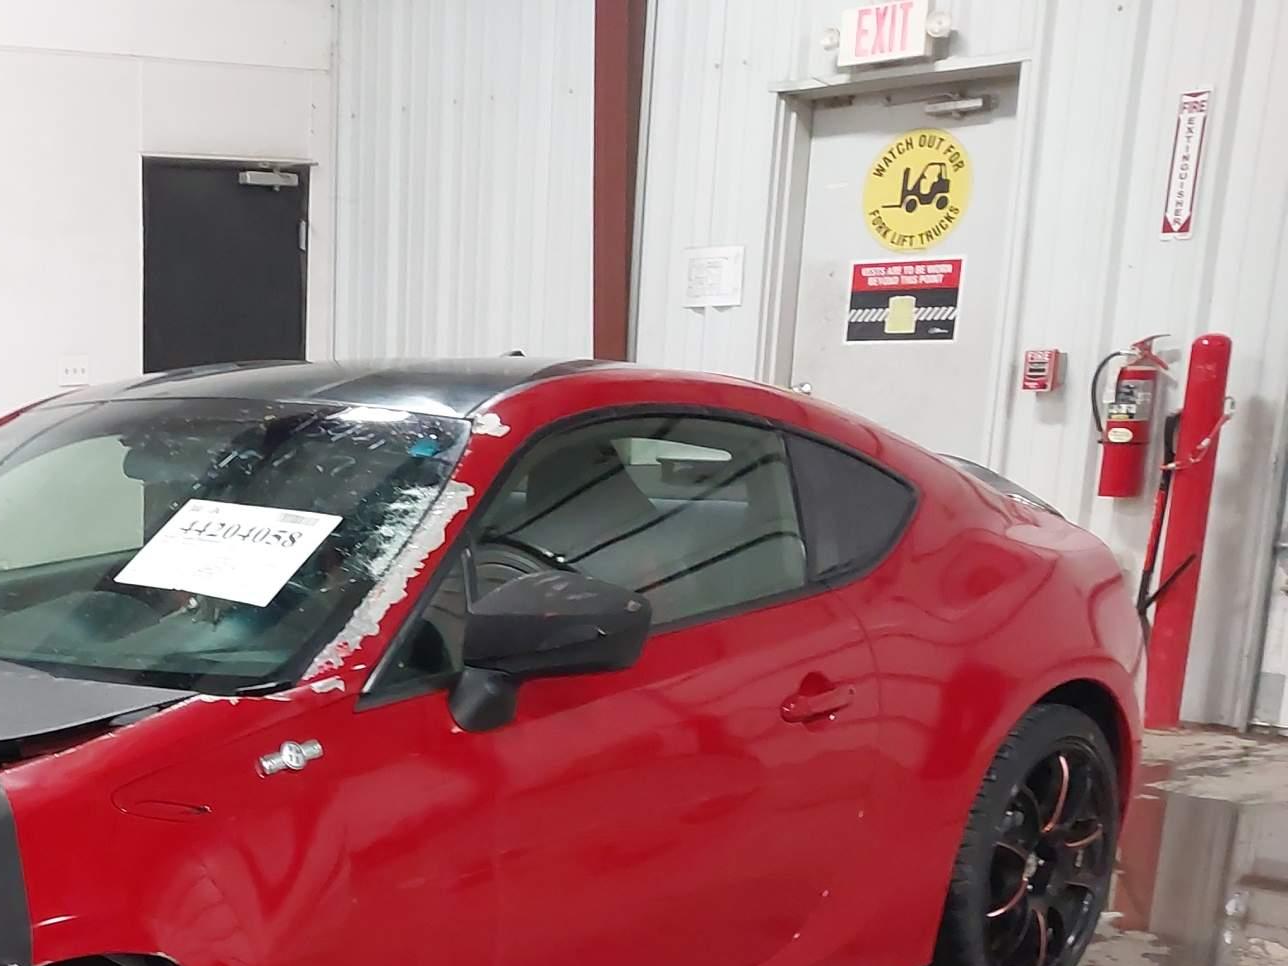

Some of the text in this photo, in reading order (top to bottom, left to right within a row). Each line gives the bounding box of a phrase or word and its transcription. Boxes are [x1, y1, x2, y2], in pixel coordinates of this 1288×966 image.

[854, 2, 914, 57] EXIT
[1181, 99, 1207, 113] FIRE
[872, 134, 966, 179] WATCH OUT FOR
[868, 205, 960, 247] FORK LIFT TRUCKS
[180, 520, 304, 548] 44204058
